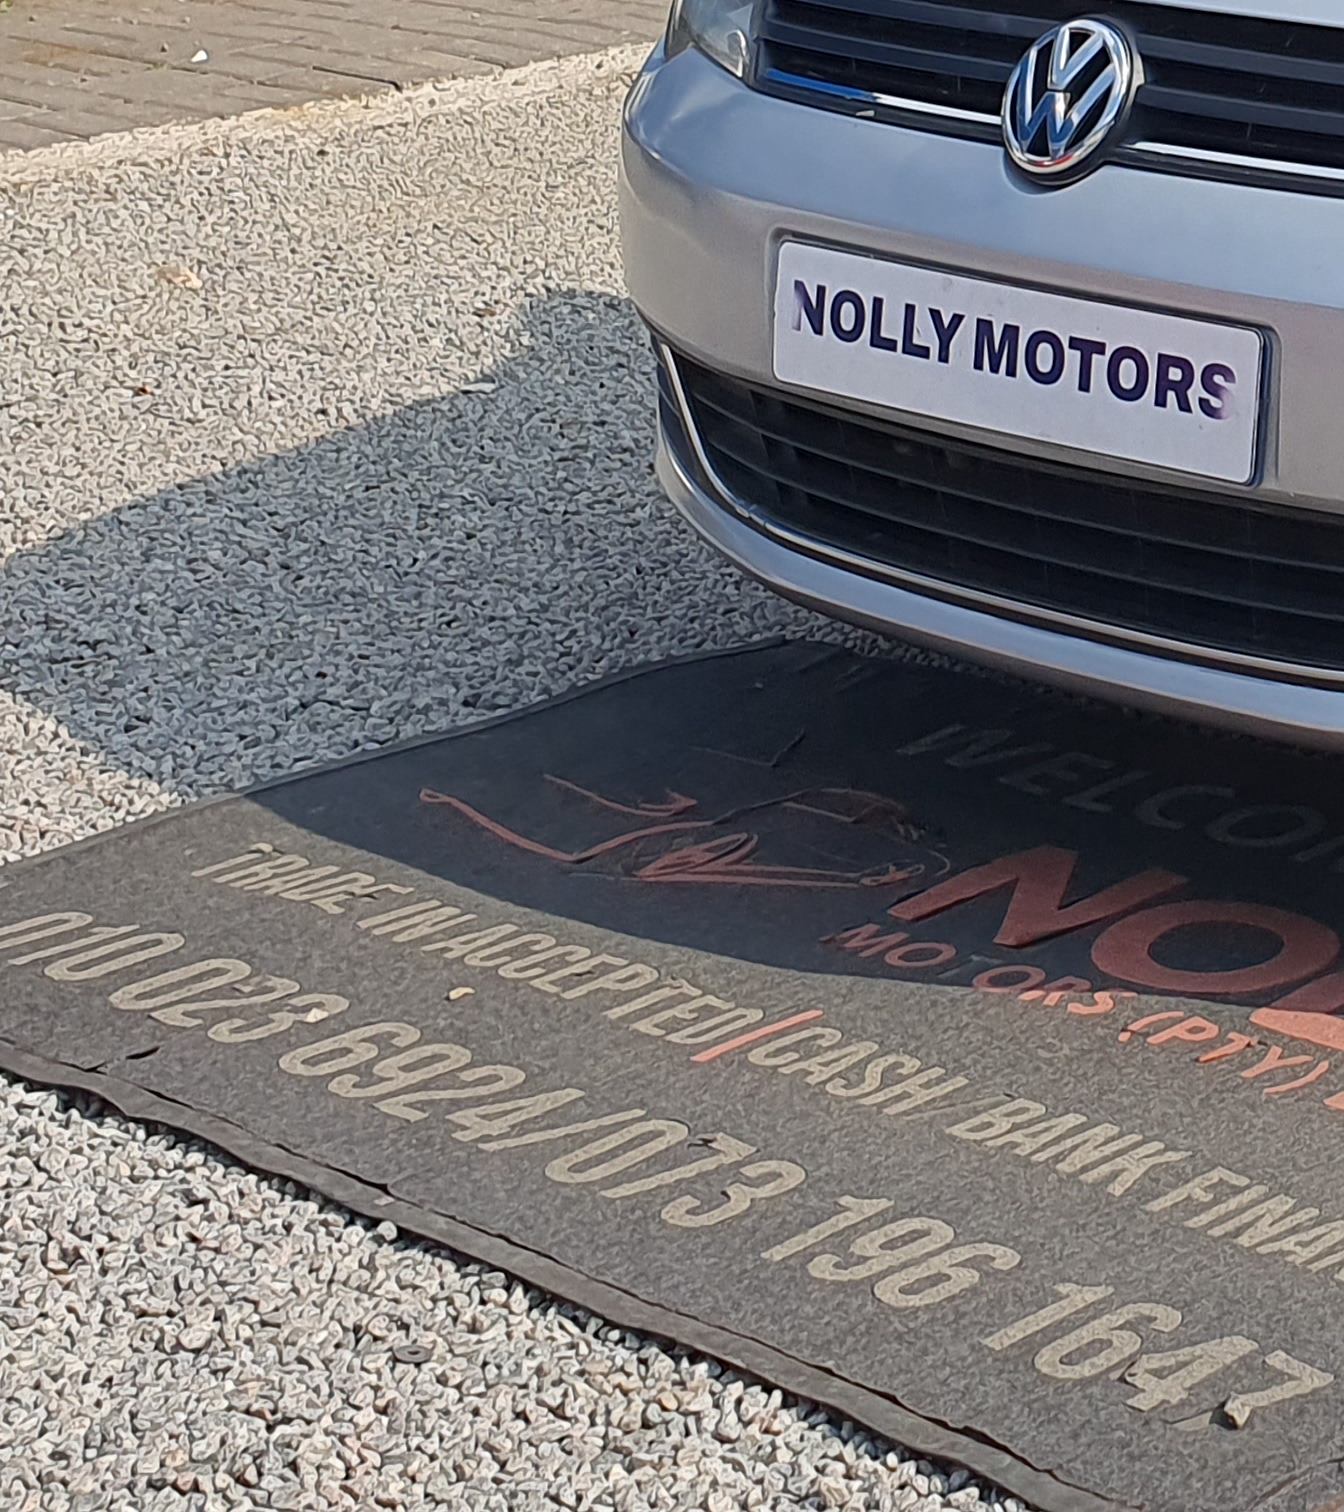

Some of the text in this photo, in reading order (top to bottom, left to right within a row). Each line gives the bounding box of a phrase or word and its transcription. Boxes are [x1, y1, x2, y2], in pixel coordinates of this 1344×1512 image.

[792, 279, 1237, 421] NOLLY MOTORS
[191, 842, 414, 915] TRADE
[357, 899, 478, 943] IN
[1118, 1009, 1330, 1096] (PTY)
[108, 957, 350, 1044] 023
[760, 1194, 1021, 1308] 196
[981, 1282, 1335, 1430] 1647
